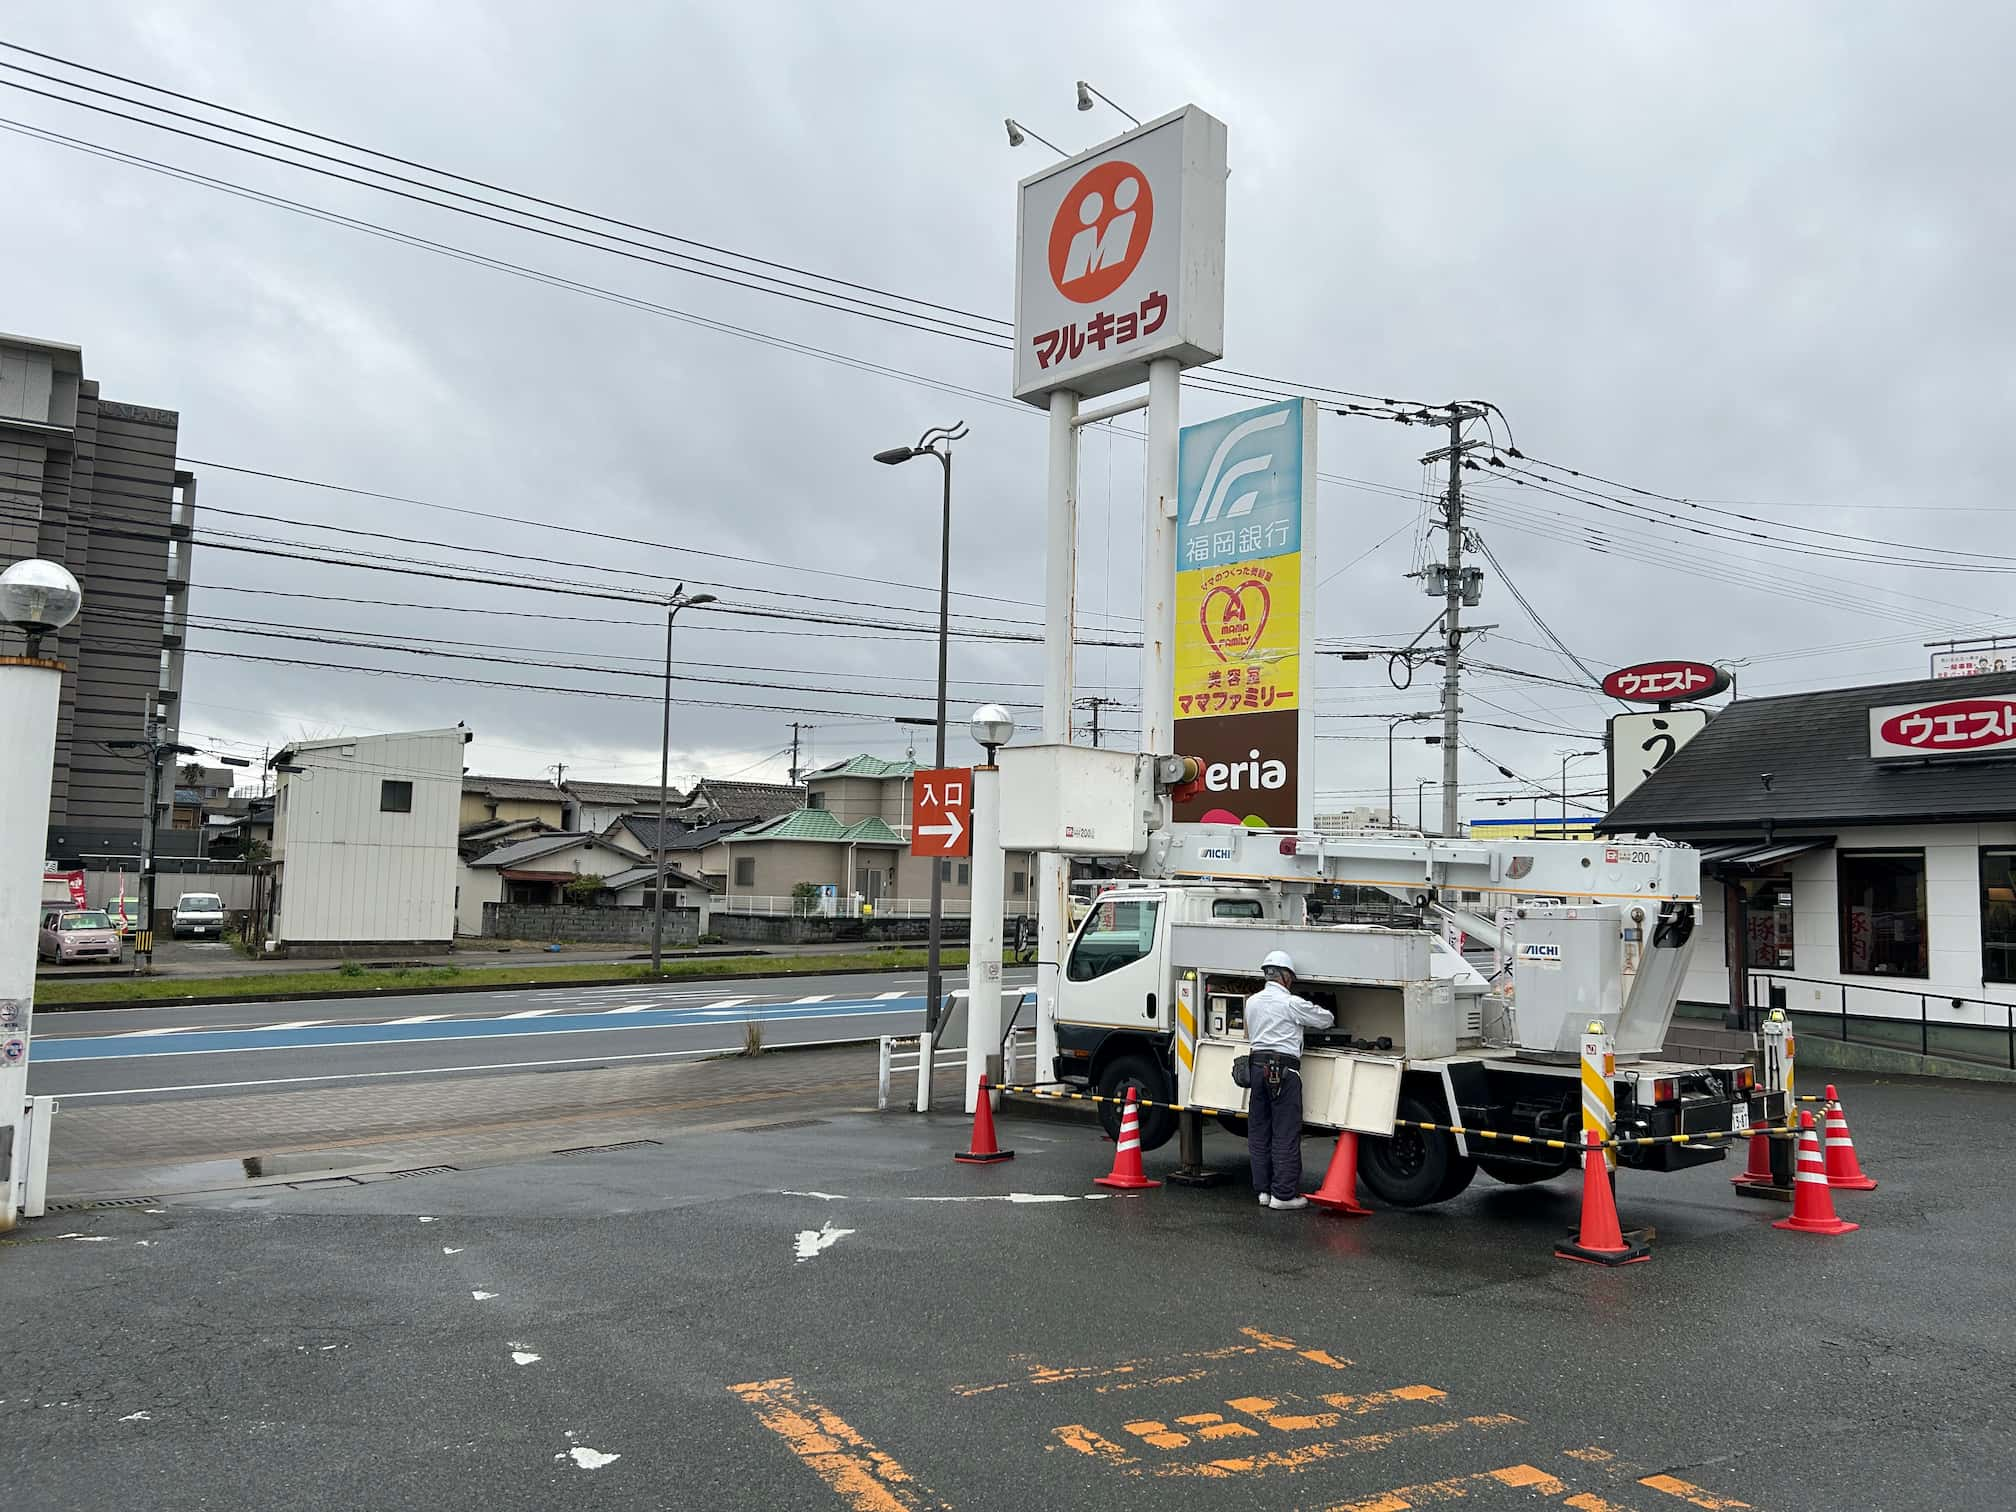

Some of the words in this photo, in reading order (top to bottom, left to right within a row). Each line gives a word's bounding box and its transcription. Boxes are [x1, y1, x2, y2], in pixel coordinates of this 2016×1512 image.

[1032, 290, 1168, 369] マルキョウ
[1186, 519, 1290, 563] 福岡銀行
[1618, 668, 1707, 695] ウエスト
[1178, 685, 1294, 713] ママファミリー
[1899, 705, 2016, 744] ウエスト
[1205, 749, 1287, 792] eria
[920, 783, 963, 807] 入口
[1203, 849, 1231, 859] AICHI
[1631, 851, 1650, 864] 200
[1523, 945, 1558, 956] AICHI
